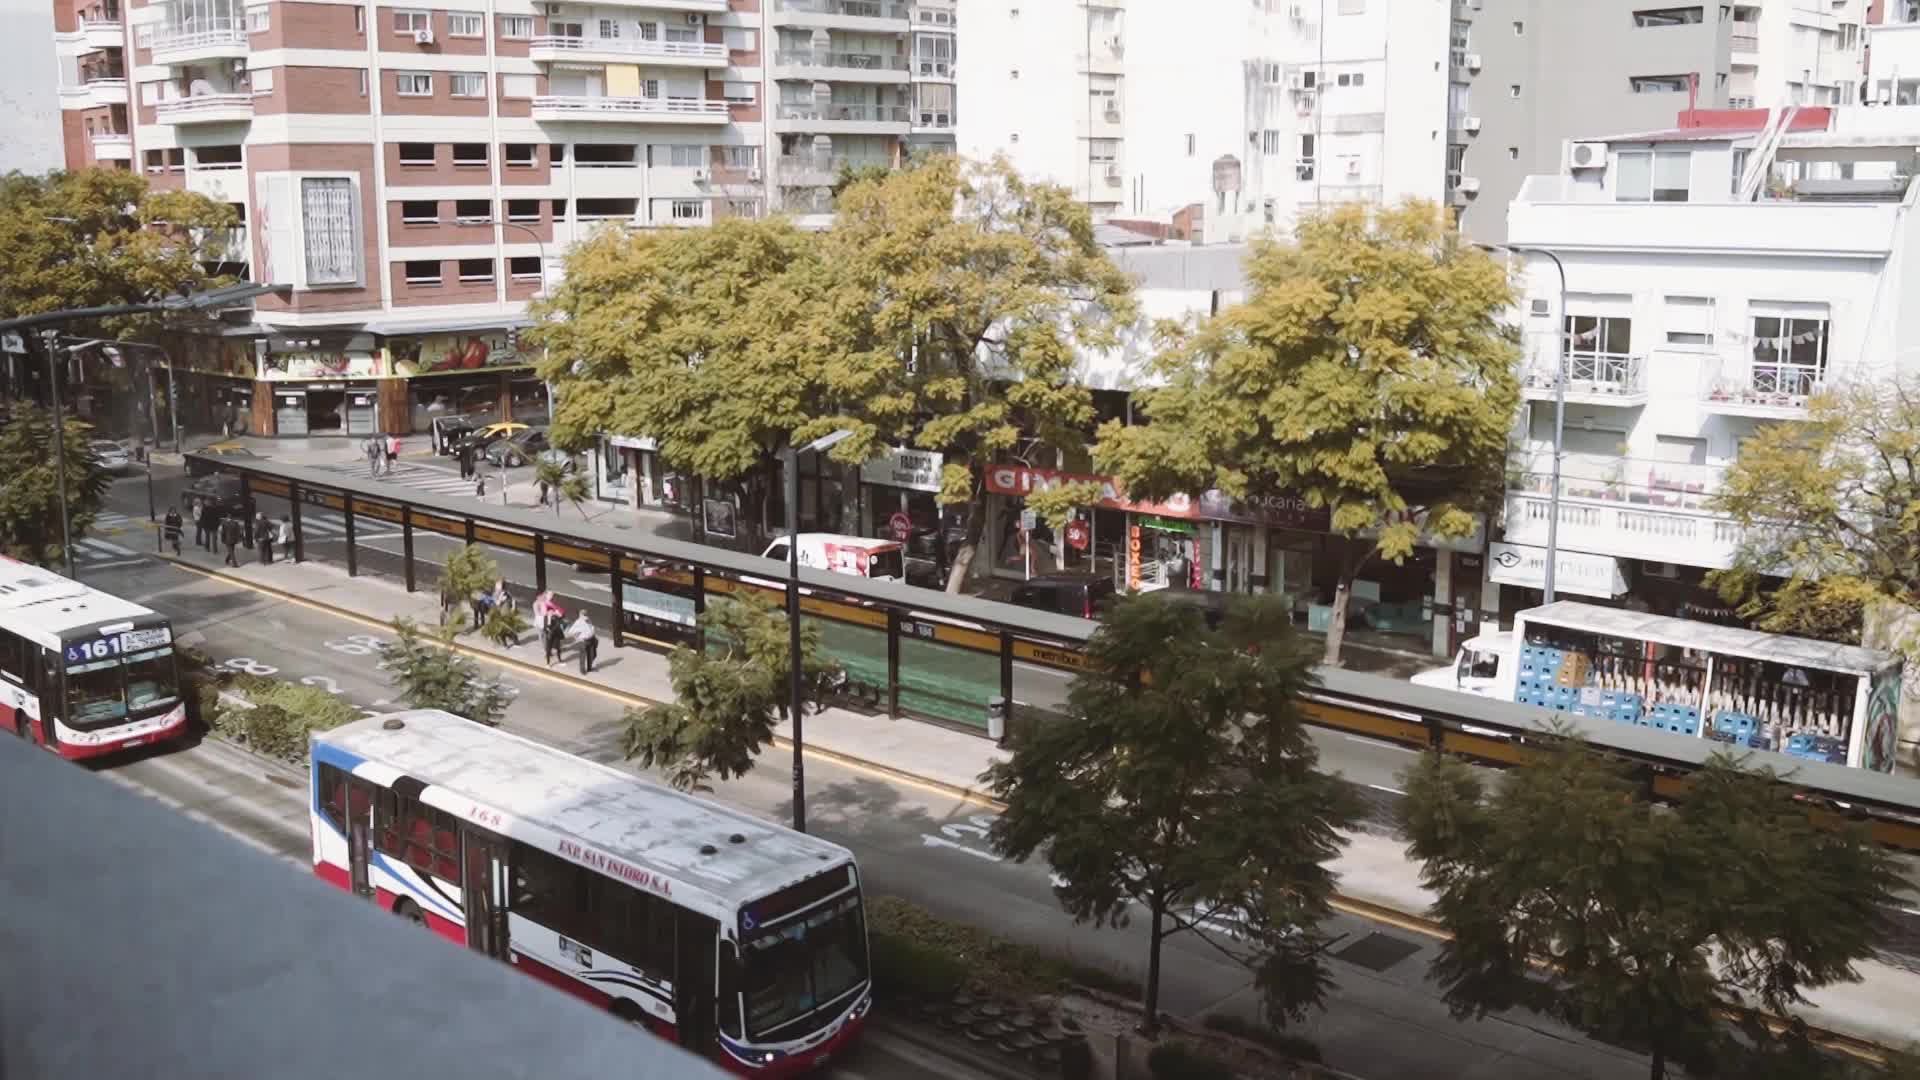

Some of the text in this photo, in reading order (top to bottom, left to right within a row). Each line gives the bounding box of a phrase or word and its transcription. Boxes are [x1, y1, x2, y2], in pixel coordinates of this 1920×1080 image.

[80, 637, 120, 659] 161
[470, 806, 502, 826] 168
[582, 850, 605, 871] SAN
[607, 858, 650, 885] ISIDRO
